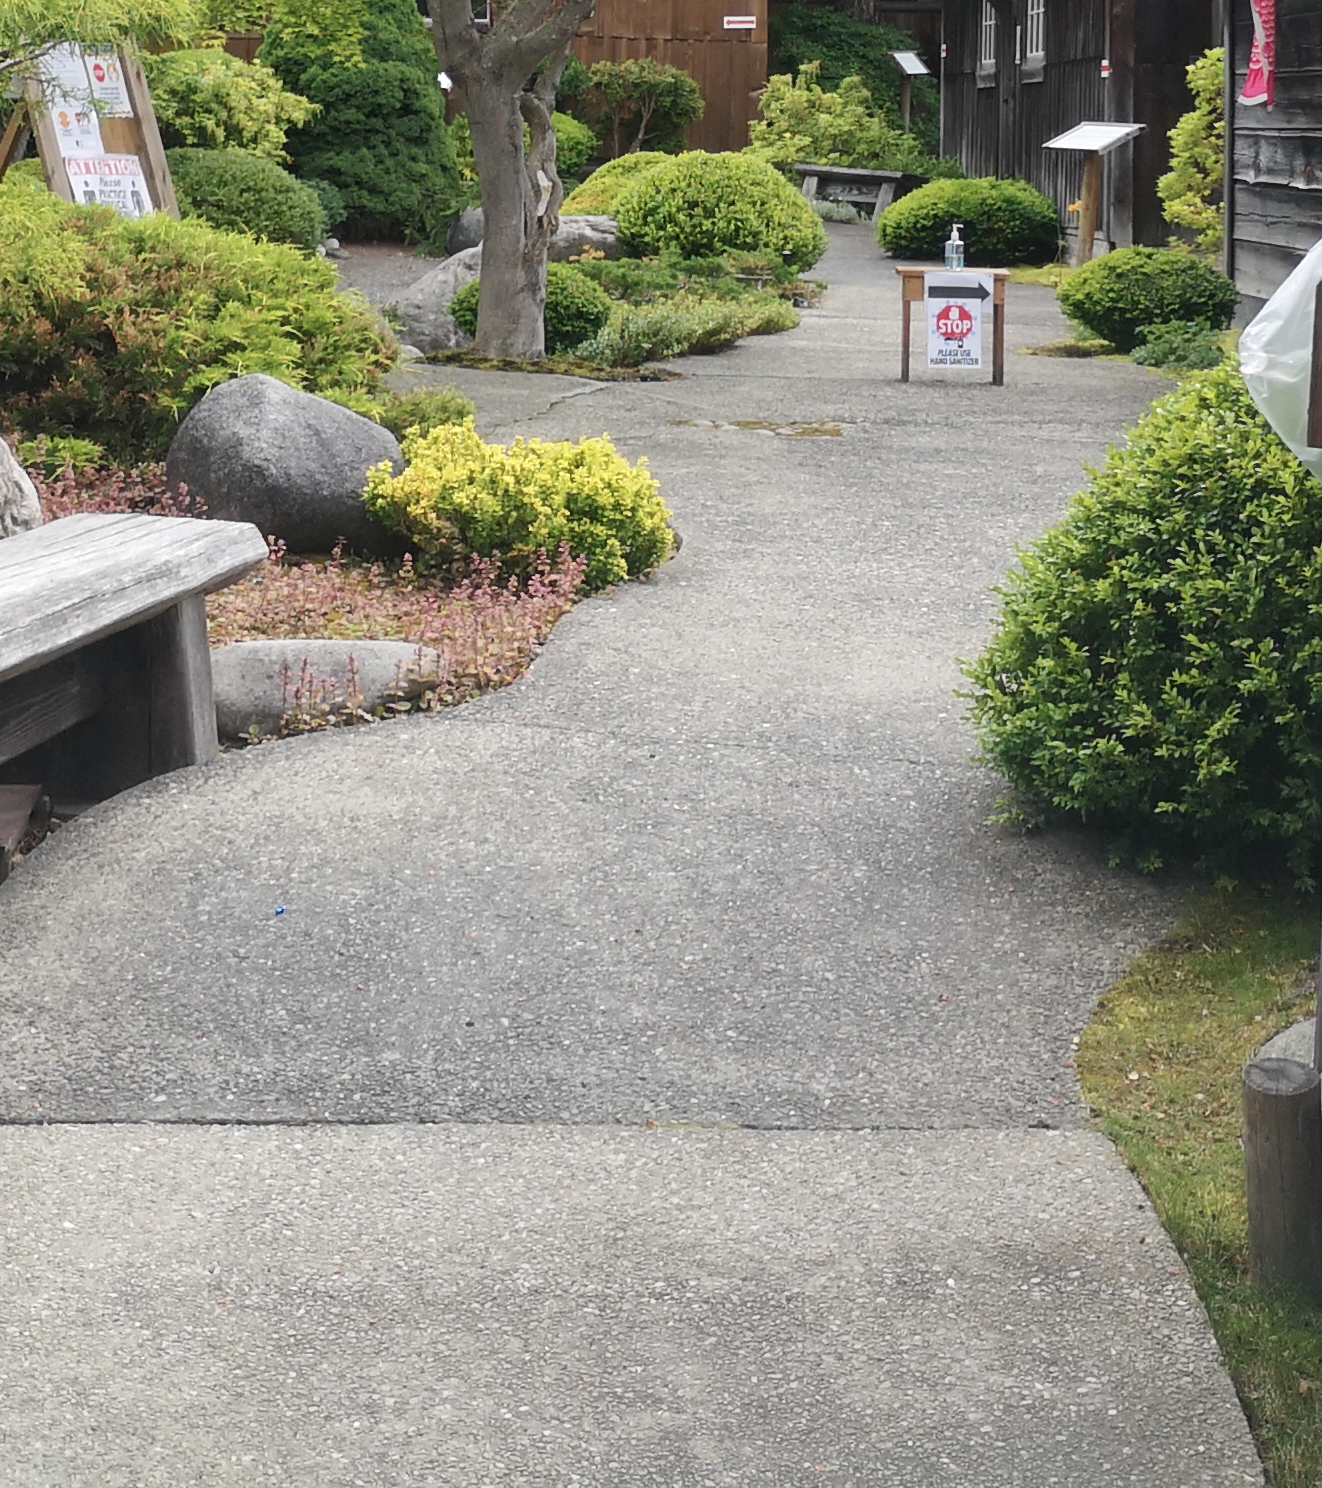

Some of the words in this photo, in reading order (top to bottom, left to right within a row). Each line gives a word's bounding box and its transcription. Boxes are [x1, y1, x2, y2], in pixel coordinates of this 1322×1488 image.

[69, 160, 139, 175] ATTENTION
[939, 320, 971, 333] STOP
[937, 349, 958, 357] PLEASE
[960, 349, 971, 357] USE
